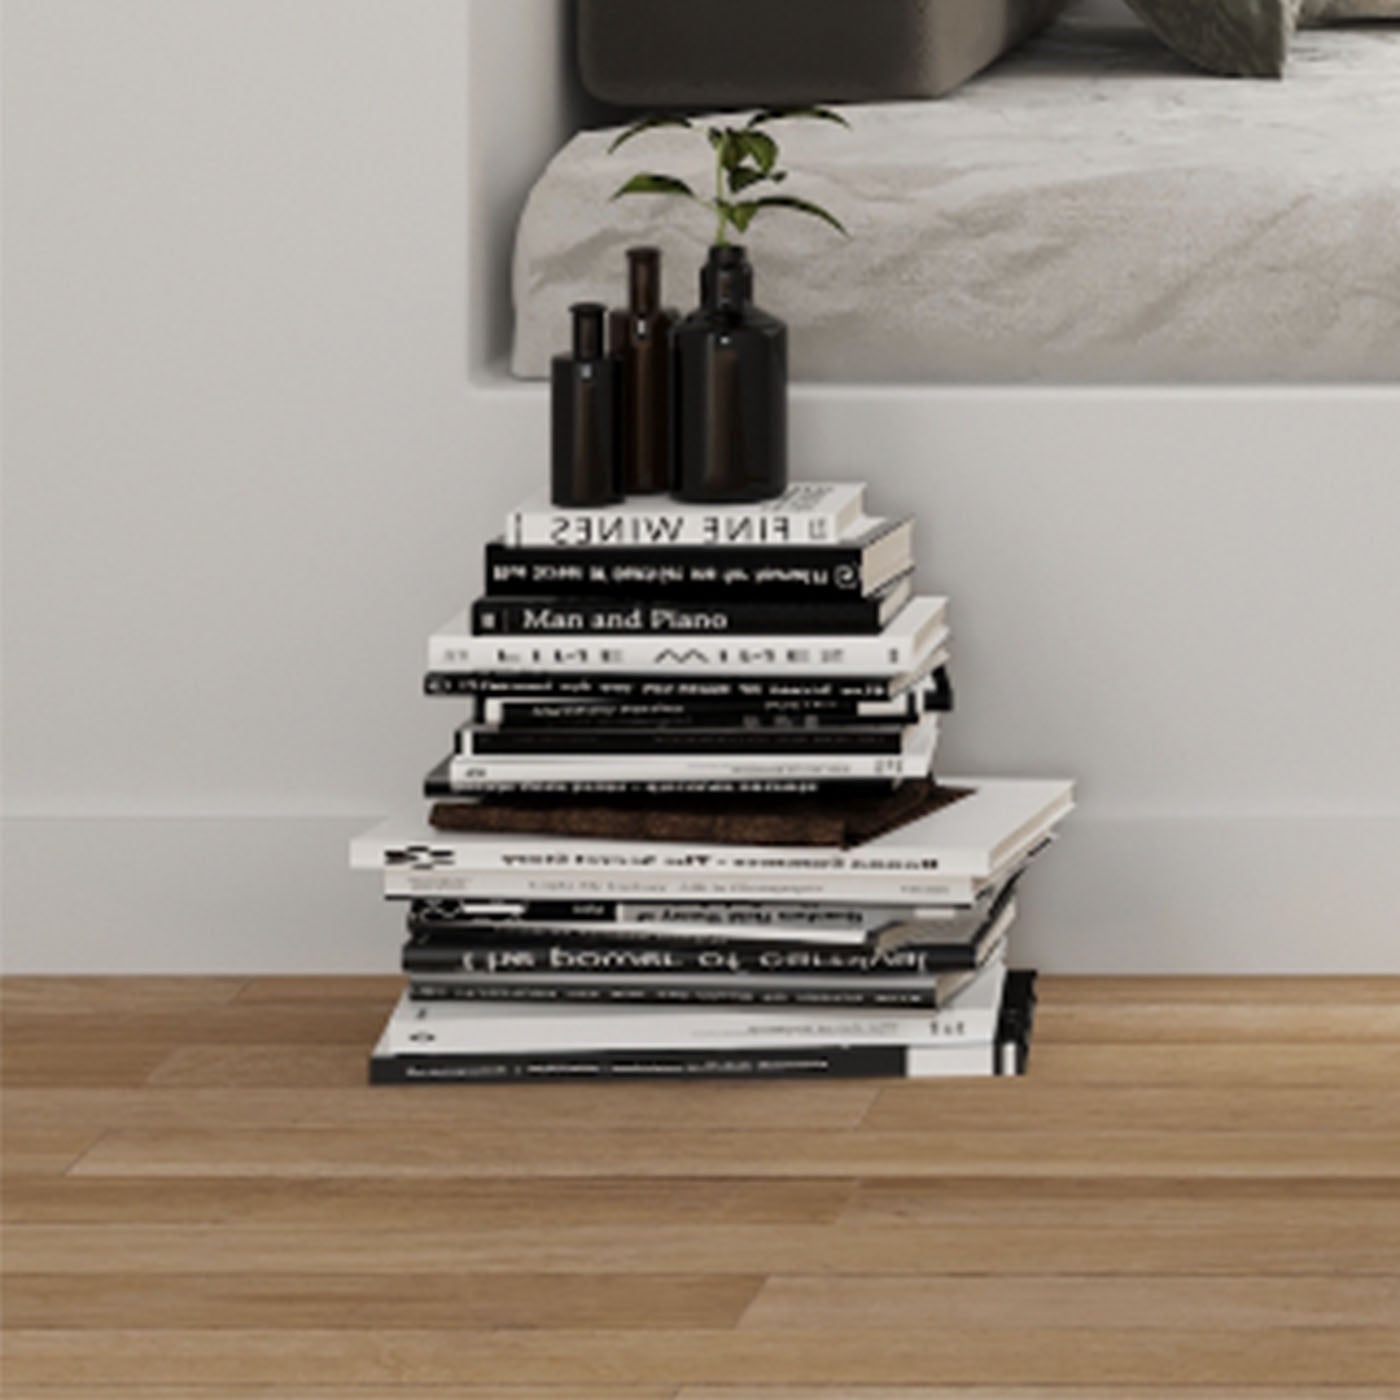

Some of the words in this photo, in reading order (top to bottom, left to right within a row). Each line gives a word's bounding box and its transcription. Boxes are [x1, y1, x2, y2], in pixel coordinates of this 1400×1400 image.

[521, 608, 585, 630] Man
[589, 608, 644, 630] and
[650, 608, 729, 630] Piano
